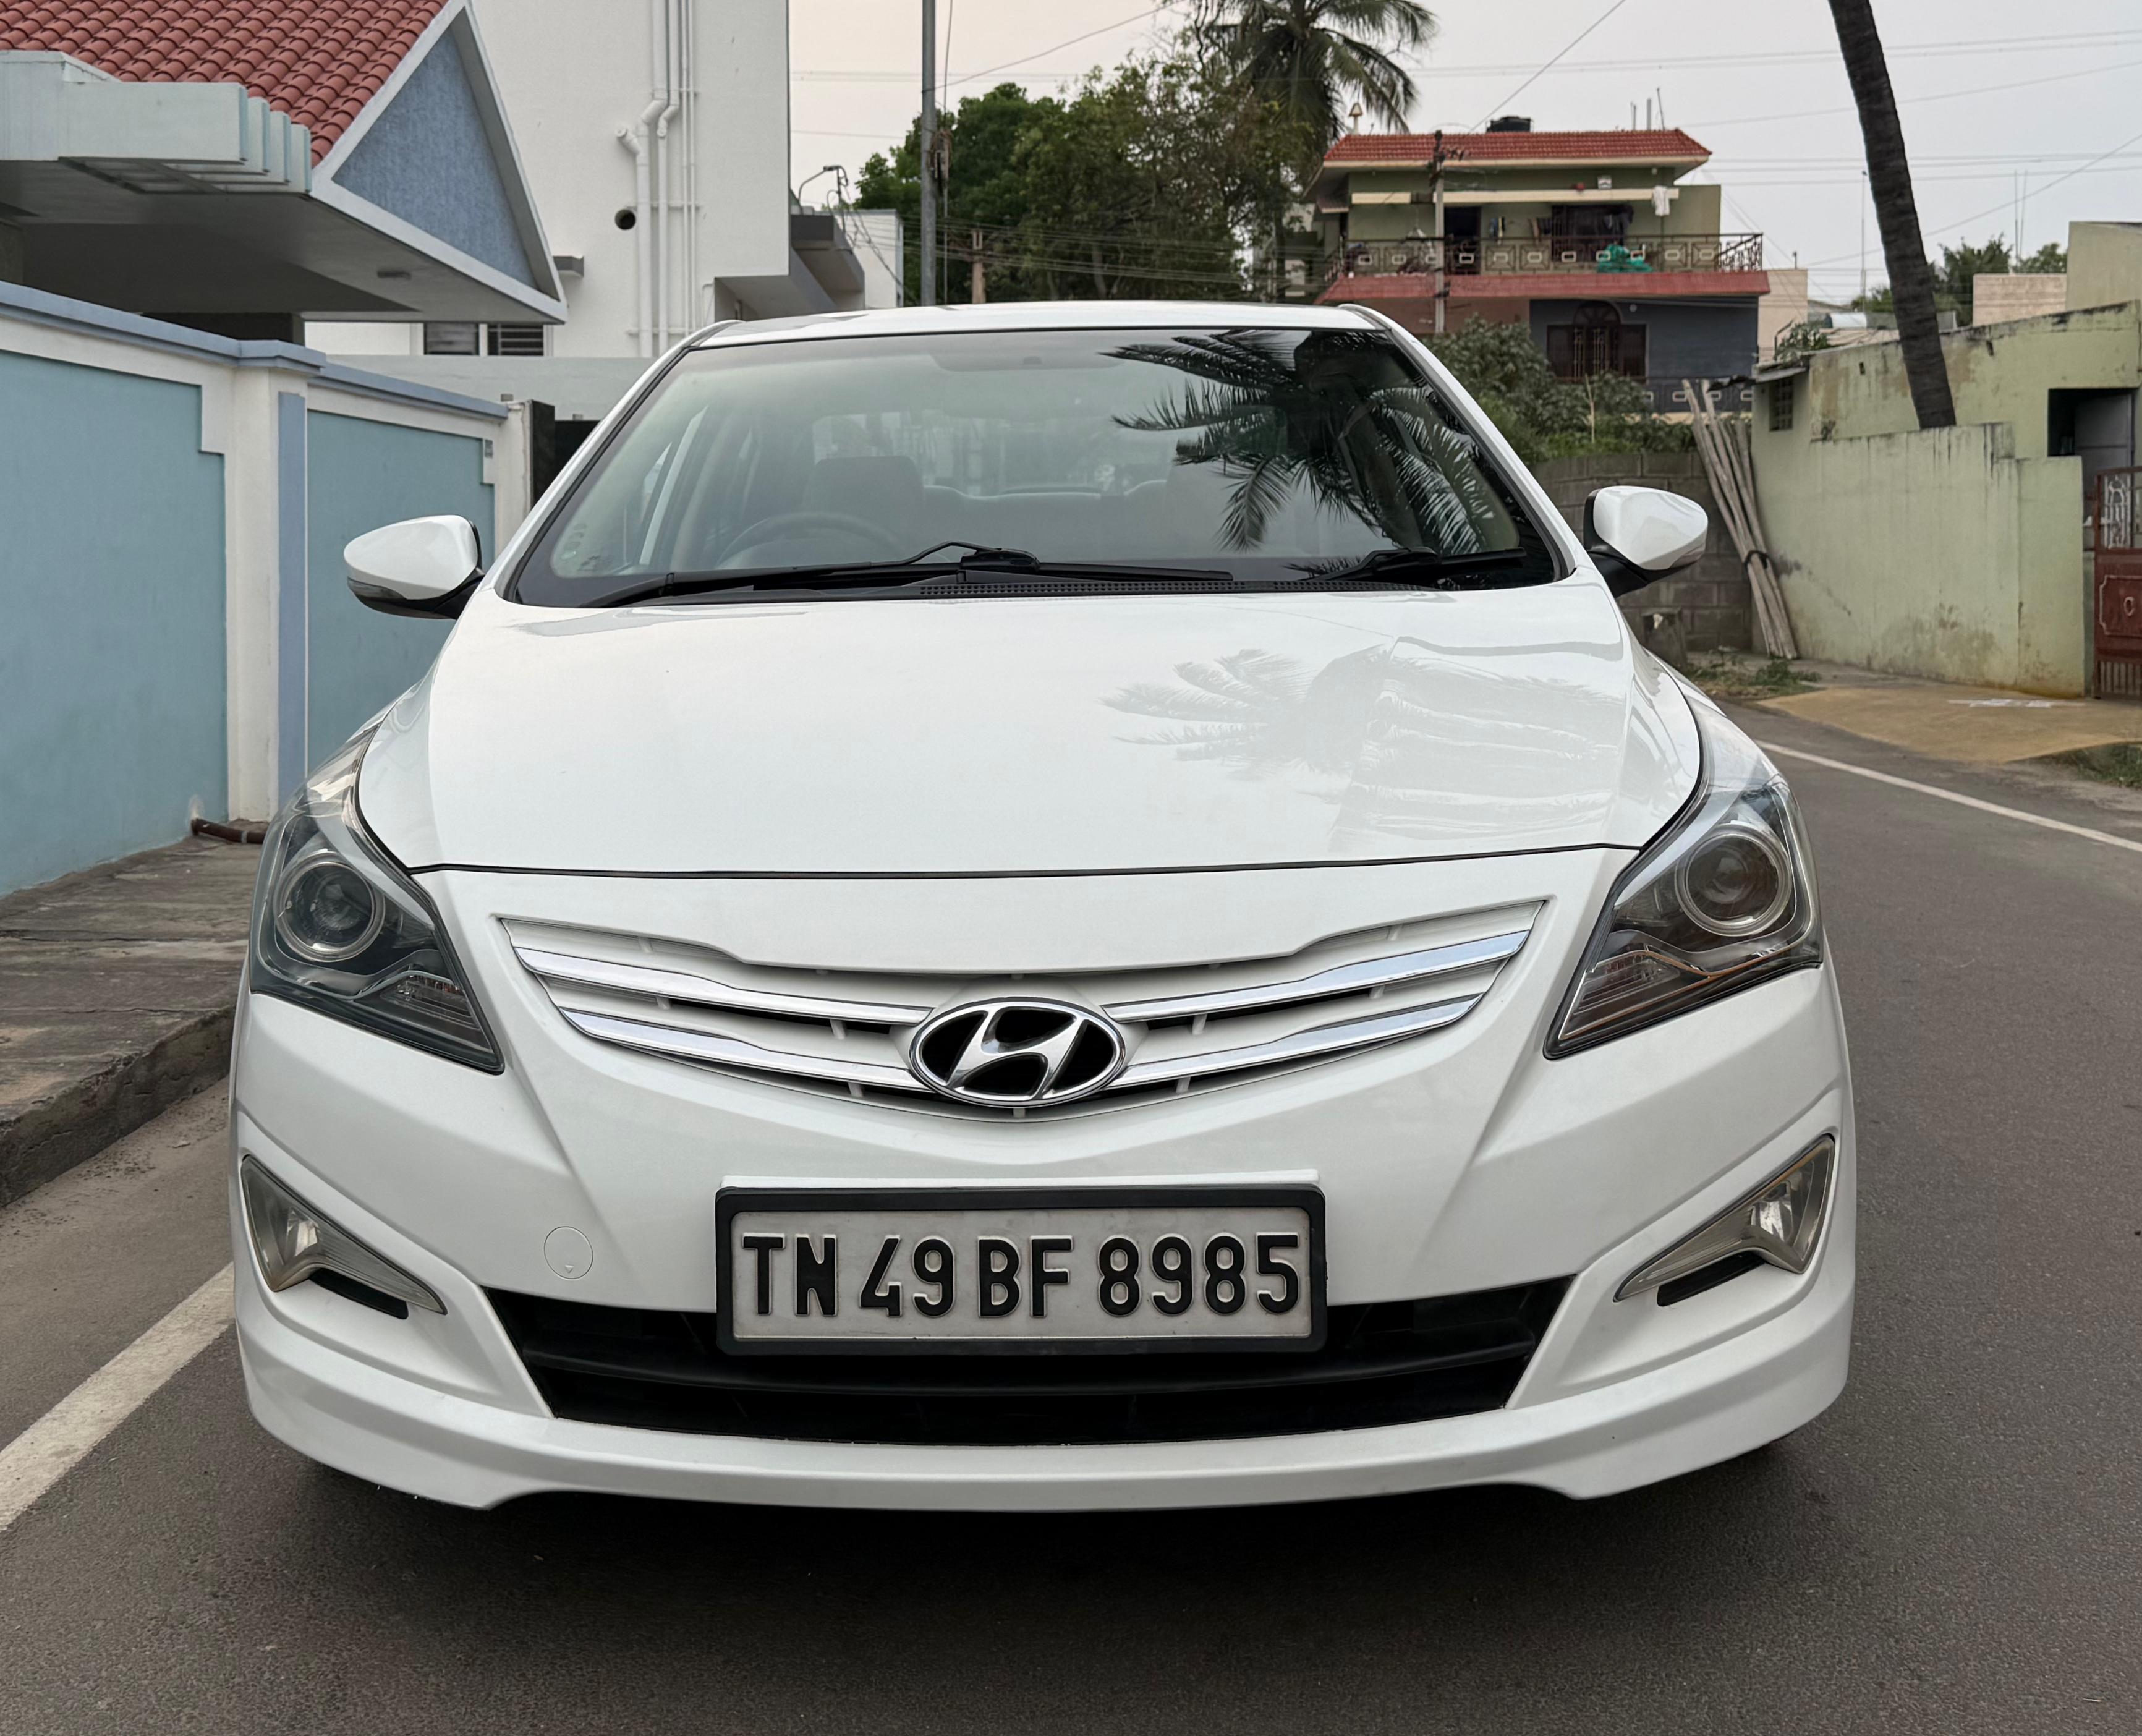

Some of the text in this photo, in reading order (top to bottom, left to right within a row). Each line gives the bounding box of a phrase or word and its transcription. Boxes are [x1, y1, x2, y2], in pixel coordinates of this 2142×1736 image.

[742, 1235, 1299, 1319] TN 49 BF 8985
